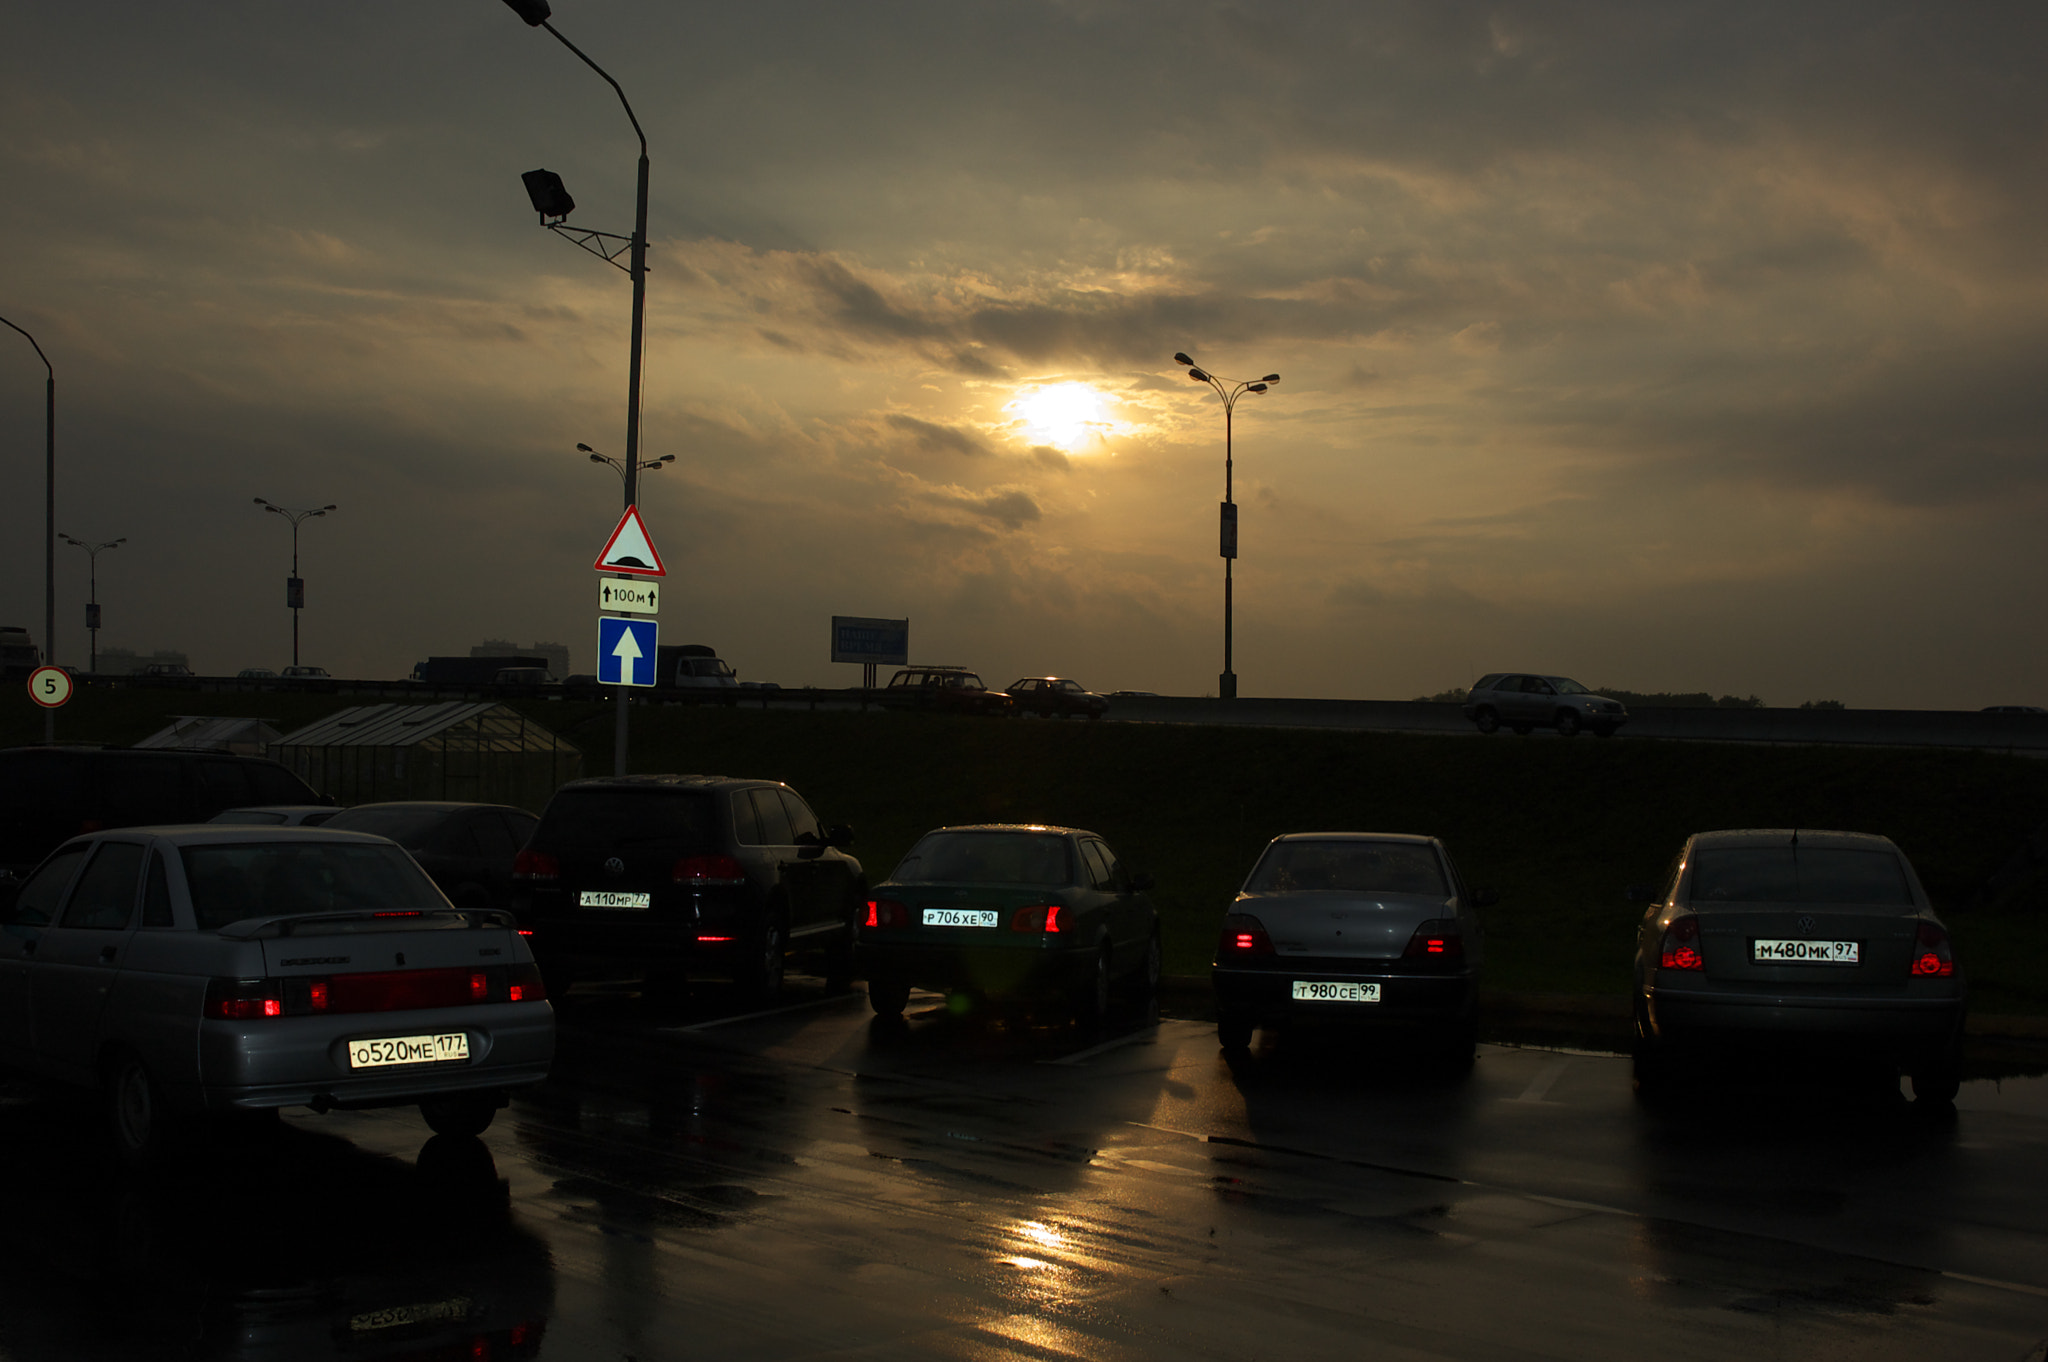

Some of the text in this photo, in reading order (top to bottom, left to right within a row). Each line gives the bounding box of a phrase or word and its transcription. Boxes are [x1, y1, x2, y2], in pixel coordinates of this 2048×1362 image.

[45, 679, 56, 694] 5
[981, 912, 993, 922] 90
[1836, 943, 1852, 955] 97
[1361, 985, 1375, 996] 99
[437, 1036, 462, 1052] 177
